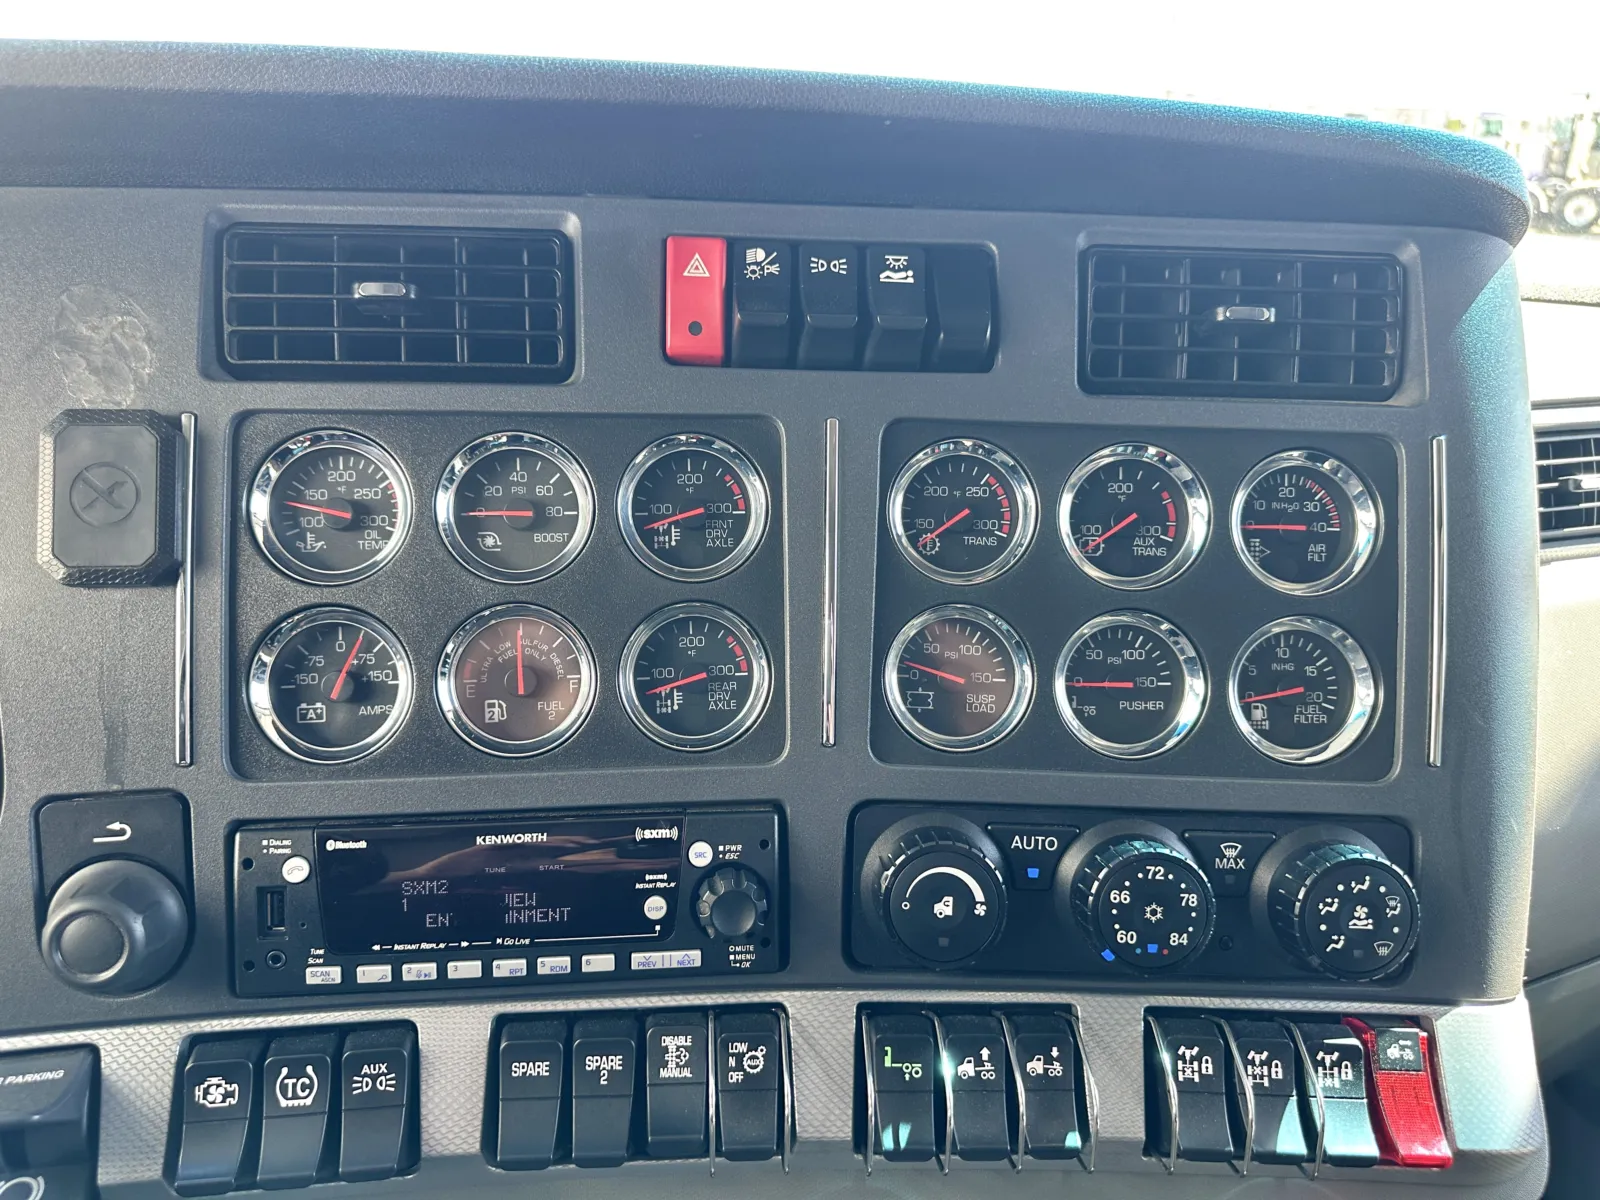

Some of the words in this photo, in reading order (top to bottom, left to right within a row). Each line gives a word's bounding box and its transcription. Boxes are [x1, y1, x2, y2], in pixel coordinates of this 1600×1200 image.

[328, 471, 355, 481] 200
[509, 472, 527, 482] 40
[677, 474, 703, 485] 200
[485, 486, 502, 497] 20
[536, 486, 553, 496] 60
[924, 486, 948, 496] 200
[966, 487, 989, 497] 250
[1108, 483, 1133, 493] 200
[1278, 487, 1295, 498] 20
[304, 489, 328, 500] 150
[354, 488, 381, 499] 250
[650, 504, 672, 514] 100
[706, 503, 732, 513] 300
[1253, 500, 1266, 510] 10
[1303, 502, 1320, 512] 30
[546, 506, 563, 517] 80
[300, 517, 324, 528] 100
[360, 515, 388, 527] 300
[706, 519, 733, 528] FRNT
[915, 519, 934, 529] 150
[973, 520, 998, 530] 300
[1080, 525, 1102, 535] 100
[1136, 526, 1161, 536] 300
[1309, 522, 1327, 533] 40
[364, 530, 382, 539] OIL
[534, 533, 569, 543] BOOST
[706, 529, 728, 538] DRV
[706, 538, 734, 547] AXLE
[963, 536, 997, 546] TRANS
[1133, 537, 1155, 546] AUX
[1132, 547, 1167, 557] TRANS
[1308, 544, 1326, 552] AIR
[1308, 553, 1327, 562] FILT
[336, 641, 346, 652] 0
[679, 636, 705, 647] 200
[495, 640, 512, 654] LOW
[923, 643, 940, 654] 50
[959, 645, 981, 655] 100
[497, 648, 518, 663] FUEL
[525, 648, 547, 661] ONLY
[945, 651, 959, 659] PSI
[1085, 650, 1103, 660] 50
[1122, 650, 1145, 660] 100
[1275, 648, 1289, 658] 10
[480, 656, 494, 683] ULTRA
[549, 653, 564, 680] DIESEL
[708, 665, 734, 676] 300
[1249, 665, 1257, 676] 5
[1304, 665, 1317, 676] 15
[651, 667, 674, 678] 100
[910, 670, 919, 680] 0
[970, 673, 991, 684] 150
[1135, 677, 1157, 688] 150
[466, 685, 476, 698] E
[569, 680, 578, 693] F
[708, 682, 737, 691] REAR
[708, 692, 731, 701] DRV
[966, 694, 996, 703] SUSP
[1306, 692, 1323, 702] 20
[358, 704, 394, 716] AMPS
[537, 701, 565, 711] FUEL
[708, 701, 737, 710] AXLE
[966, 703, 996, 713] LOAD
[1119, 701, 1164, 710] PUSHER
[1296, 705, 1322, 714] FUEL
[548, 711, 556, 720] 2
[1294, 714, 1327, 723] FILTER
[476, 832, 547, 846] KENWORTH
[1010, 835, 1058, 851] AUTO
[725, 844, 742, 852] PWR
[694, 851, 707, 859] SRC
[725, 852, 740, 860] ESC
[1215, 858, 1245, 870] MAX
[1146, 866, 1165, 880] 72
[402, 880, 449, 895] SXM2
[1110, 890, 1130, 904] 66
[1180, 893, 1198, 907] 78
[1116, 930, 1137, 944] 60
[1169, 933, 1188, 946] 84
[637, 960, 657, 969] PREV
[677, 958, 696, 967] NEXT
[310, 970, 331, 978] SCAN
[509, 967, 524, 975] RPT
[550, 965, 568, 973] RDM
[661, 1035, 692, 1046] DISABLE
[728, 1042, 748, 1053] LOW
[585, 1055, 623, 1071] SPARE
[728, 1056, 736, 1067] N
[361, 1062, 388, 1075] AUX
[511, 1061, 550, 1077] SPARE
[659, 1067, 693, 1078] MANUAL
[4, 1069, 65, 1085] PARKING
[600, 1070, 608, 1085] 2
[728, 1072, 744, 1083] OFF
[283, 1078, 311, 1098] TC
